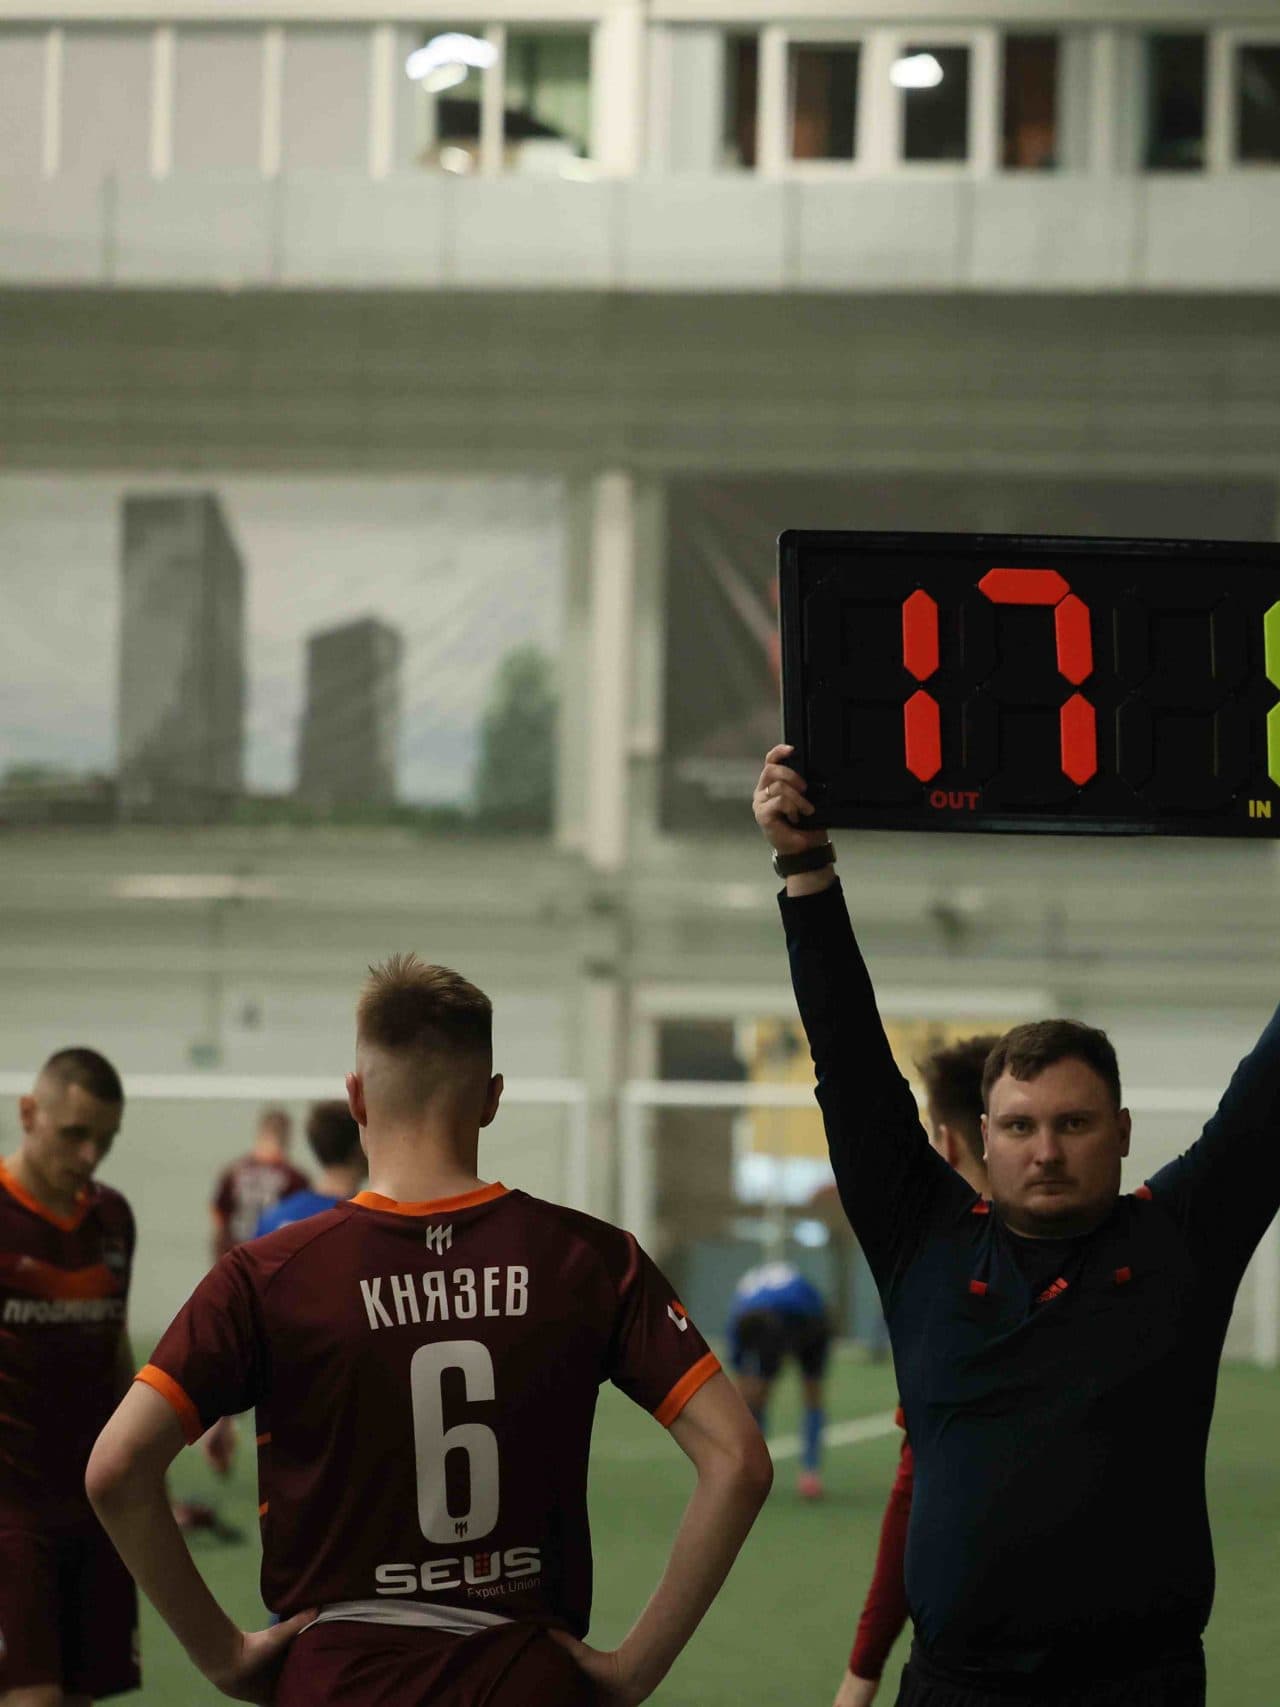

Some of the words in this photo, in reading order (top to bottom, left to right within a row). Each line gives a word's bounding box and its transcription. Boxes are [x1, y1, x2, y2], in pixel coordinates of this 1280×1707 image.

[901, 567, 1099, 787] 17
[929, 790, 980, 810] OUT
[1247, 799, 1272, 819] IN
[359, 1265, 529, 1331] КНЯЗЕВ
[409, 1339, 500, 1545] 6
[374, 1546, 542, 1595] SEUS
[466, 1583, 504, 1600] Export
[507, 1576, 542, 1594] Union
